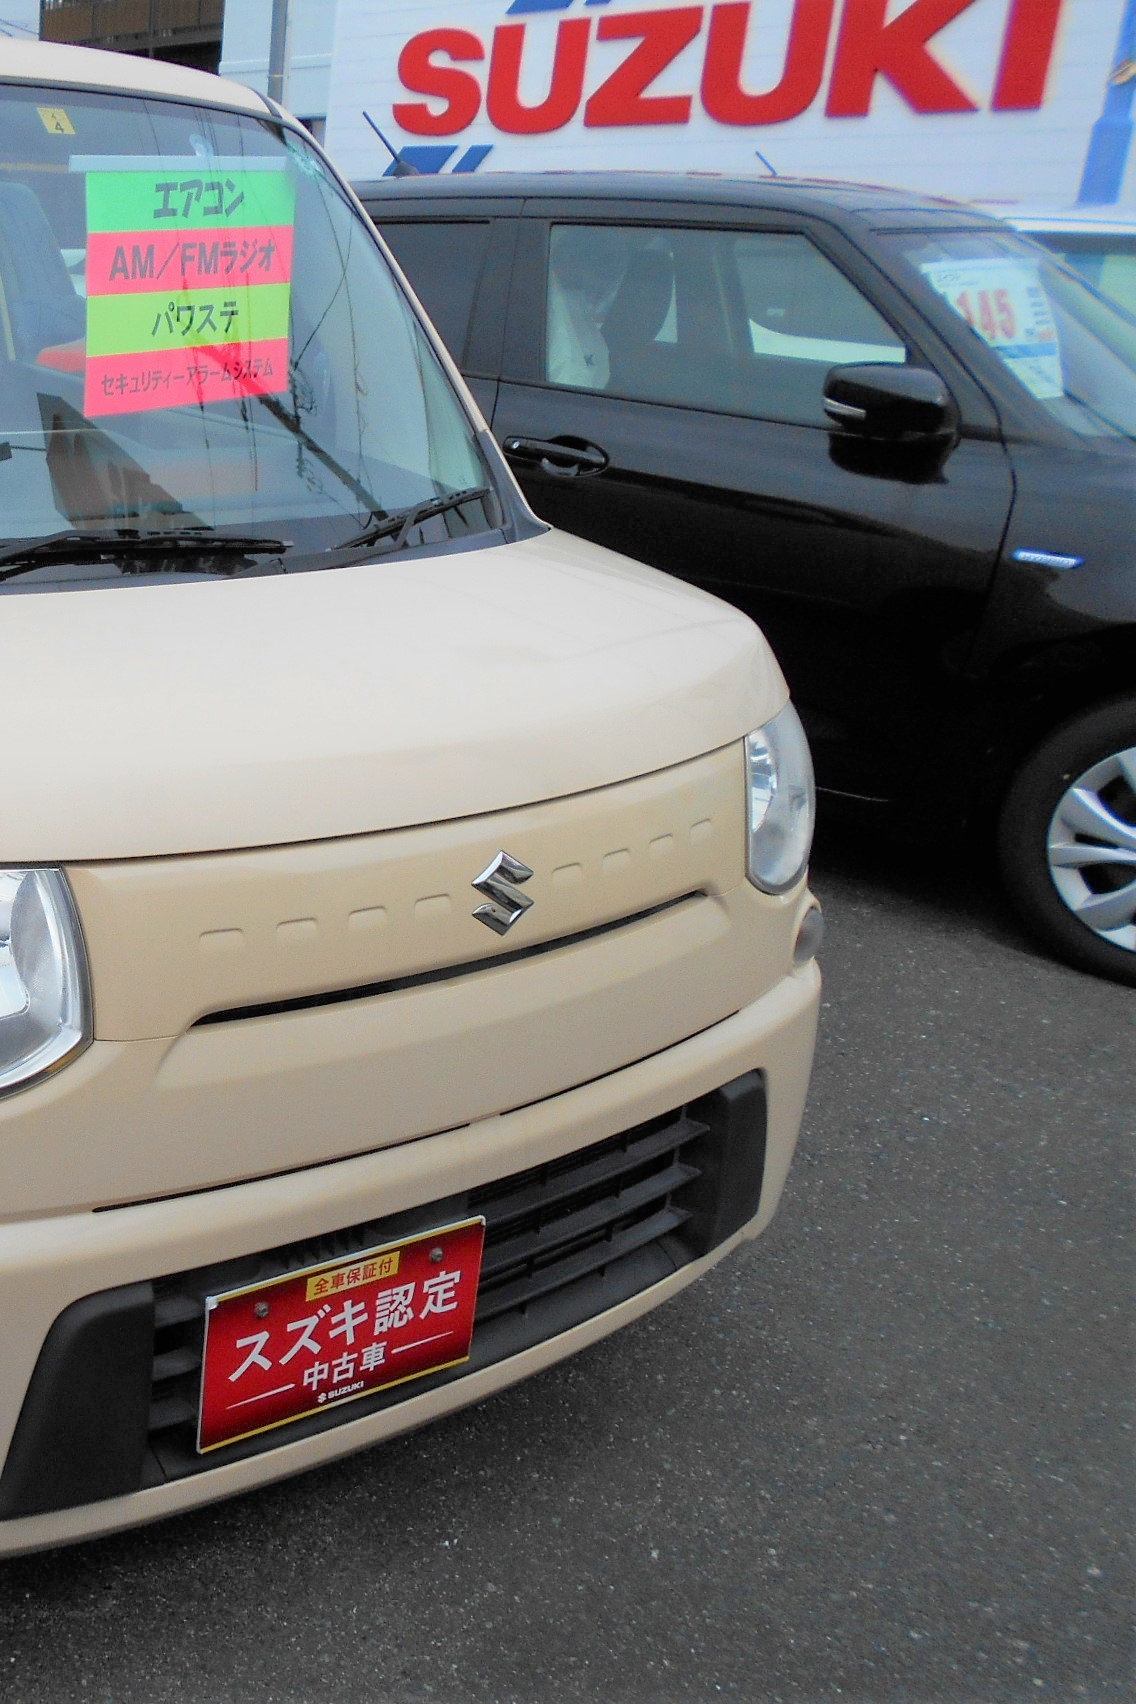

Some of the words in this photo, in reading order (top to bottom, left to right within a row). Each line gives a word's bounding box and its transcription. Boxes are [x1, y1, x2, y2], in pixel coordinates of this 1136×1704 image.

[392, 0, 1066, 136] SUZUKI
[153, 178, 245, 219] エアコン
[151, 301, 239, 337] パワステ
[101, 358, 274, 396] セキュリティーアラームシステム
[313, 1257, 395, 1296] 全車保証付
[228, 1270, 461, 1382] スズキ認定
[302, 1340, 388, 1391] 中古車
[327, 1381, 364, 1399] SUZUKI
